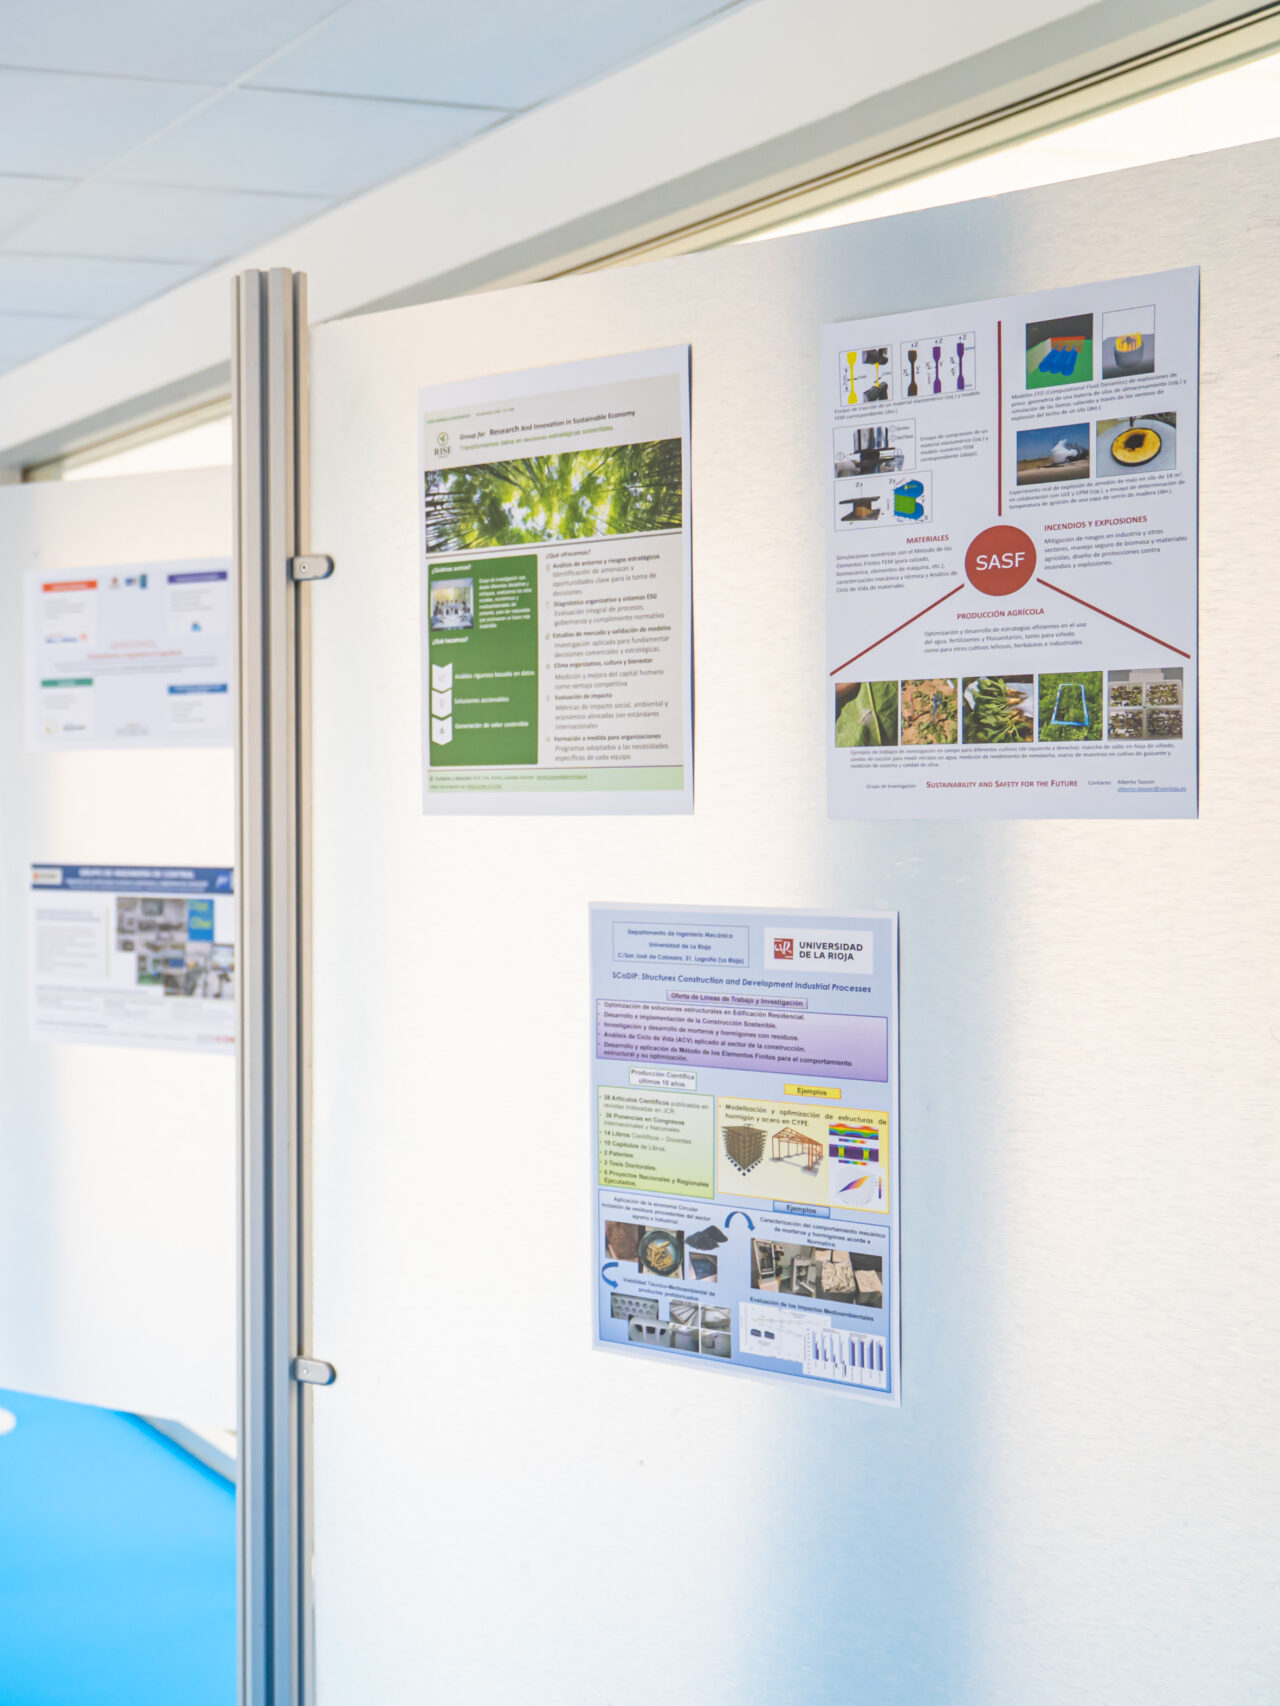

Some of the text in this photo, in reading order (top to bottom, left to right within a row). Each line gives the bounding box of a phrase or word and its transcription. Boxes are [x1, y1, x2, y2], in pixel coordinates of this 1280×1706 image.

[490, 425, 519, 436] Research
[521, 424, 533, 432] And
[534, 420, 565, 430] Innovation
[573, 414, 607, 425] Sustainable
[608, 410, 636, 421] Economy
[435, 446, 452, 456] RISE
[1044, 522, 1087, 532] INCENDIOS
[1095, 516, 1148, 527] EXPLOSIONES
[906, 535, 949, 544] MATERIALES
[1045, 536, 1074, 545] Mitigación
[1084, 534, 1105, 542] riesgos
[1115, 530, 1142, 538] industria
[976, 552, 1026, 571] SASF
[957, 607, 1045, 620] PRODUCCIÓN AGRÍCOLA
[800, 942, 863, 951] UNIVERSIDAD
[800, 951, 812, 959] DE
[827, 952, 854, 961] RIOJA
[641, 974, 676, 982] Structures
[677, 976, 724, 985] Construction
[725, 978, 741, 986] and
[742, 979, 793, 990] Development
[795, 982, 830, 990] Industrial
[832, 984, 871, 993] Processes
[731, 996, 754, 1005] Trabajo
[761, 998, 803, 1008] Investigación
[797, 1088, 827, 1097] Ejemplos
[725, 1113, 755, 1123] hormigón
[726, 1104, 766, 1114] Modelización
[780, 1109, 820, 1120] optimización
[838, 1115, 873, 1124] estructuras
[786, 1205, 816, 1216] Ejemplos
